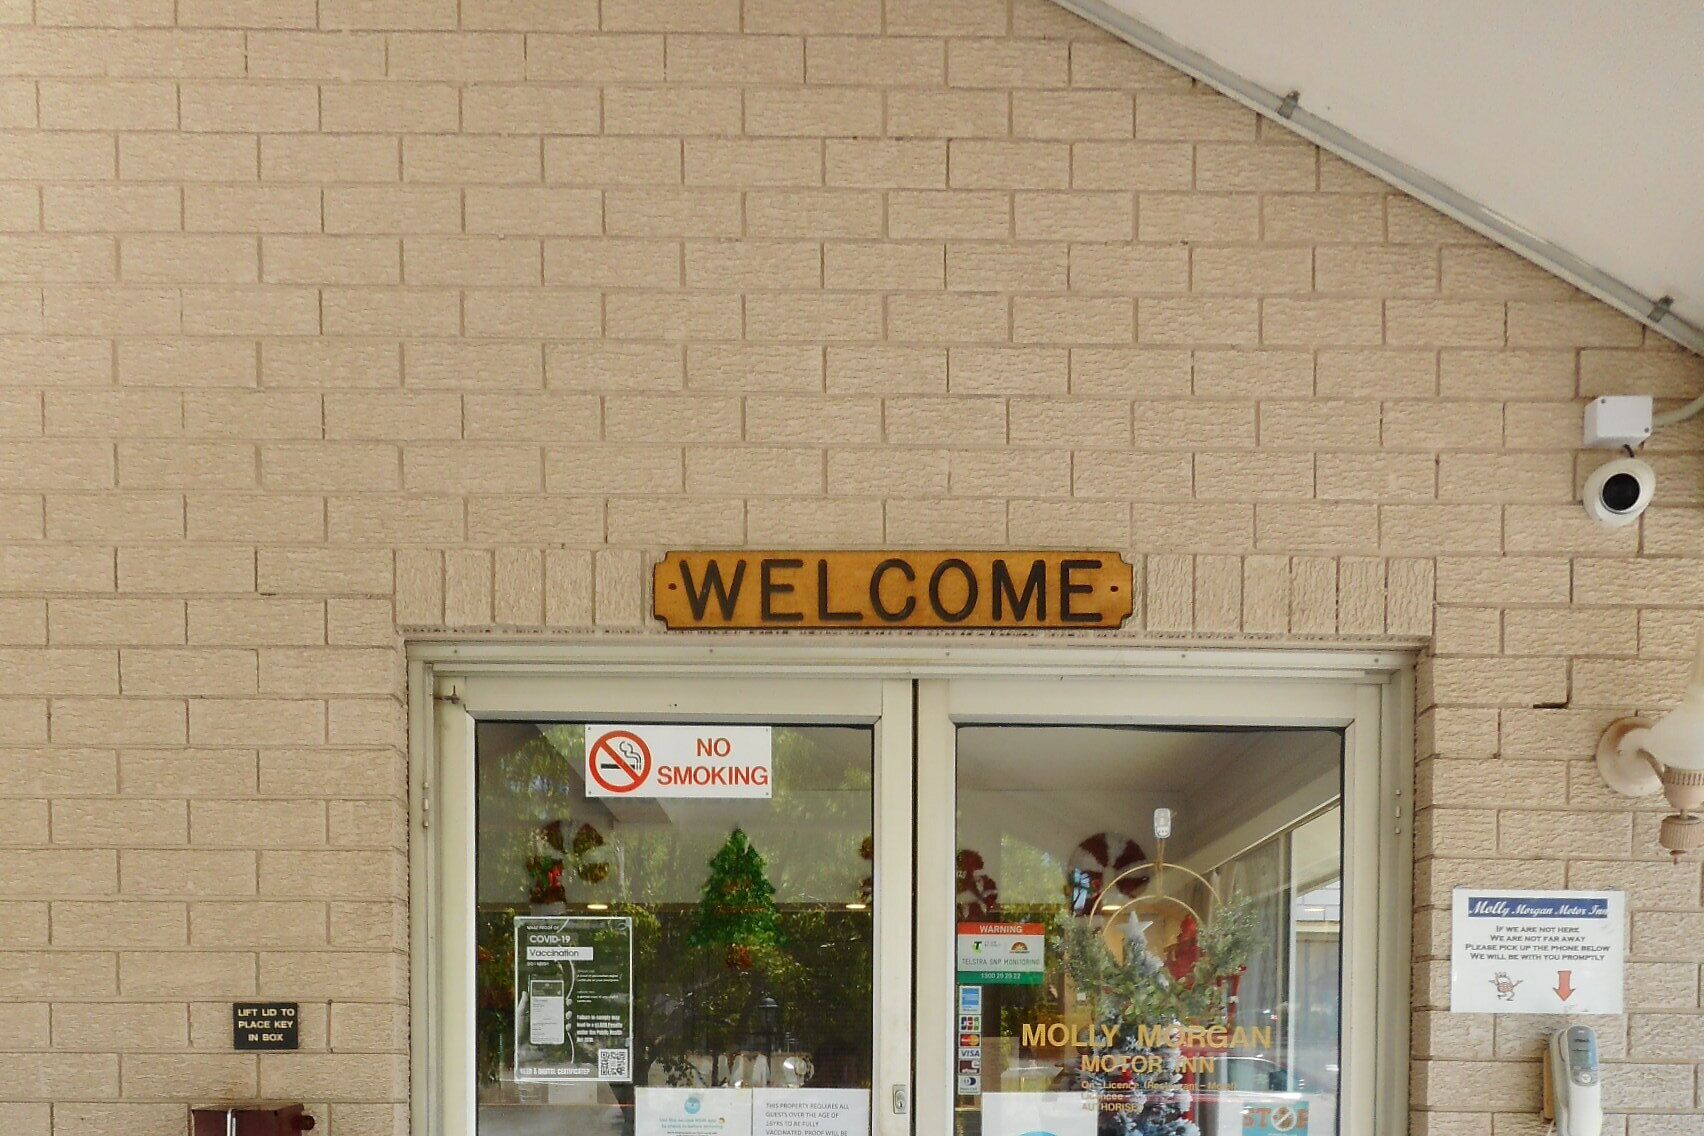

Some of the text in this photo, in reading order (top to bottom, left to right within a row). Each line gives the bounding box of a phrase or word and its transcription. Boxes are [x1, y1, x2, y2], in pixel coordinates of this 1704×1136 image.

[680, 558, 1102, 622] WELCOME
[696, 737, 731, 757] NO
[657, 766, 768, 785] SMOKING
[1469, 901, 1607, 917] Molly Morgan Motor Inn
[980, 925, 1023, 933] WARNING
[530, 935, 570, 943] COVID-19
[530, 949, 579, 957] Vaccination
[280, 1008, 295, 1016] TO
[238, 1020, 293, 1029] PLACE KEY
[248, 1033, 283, 1041] IN BOX
[1022, 1023, 1271, 1049] MOLLY MORGAN
[1081, 1055, 1215, 1073] MOTOR INN
[1103, 1081, 1139, 1089] Licence
